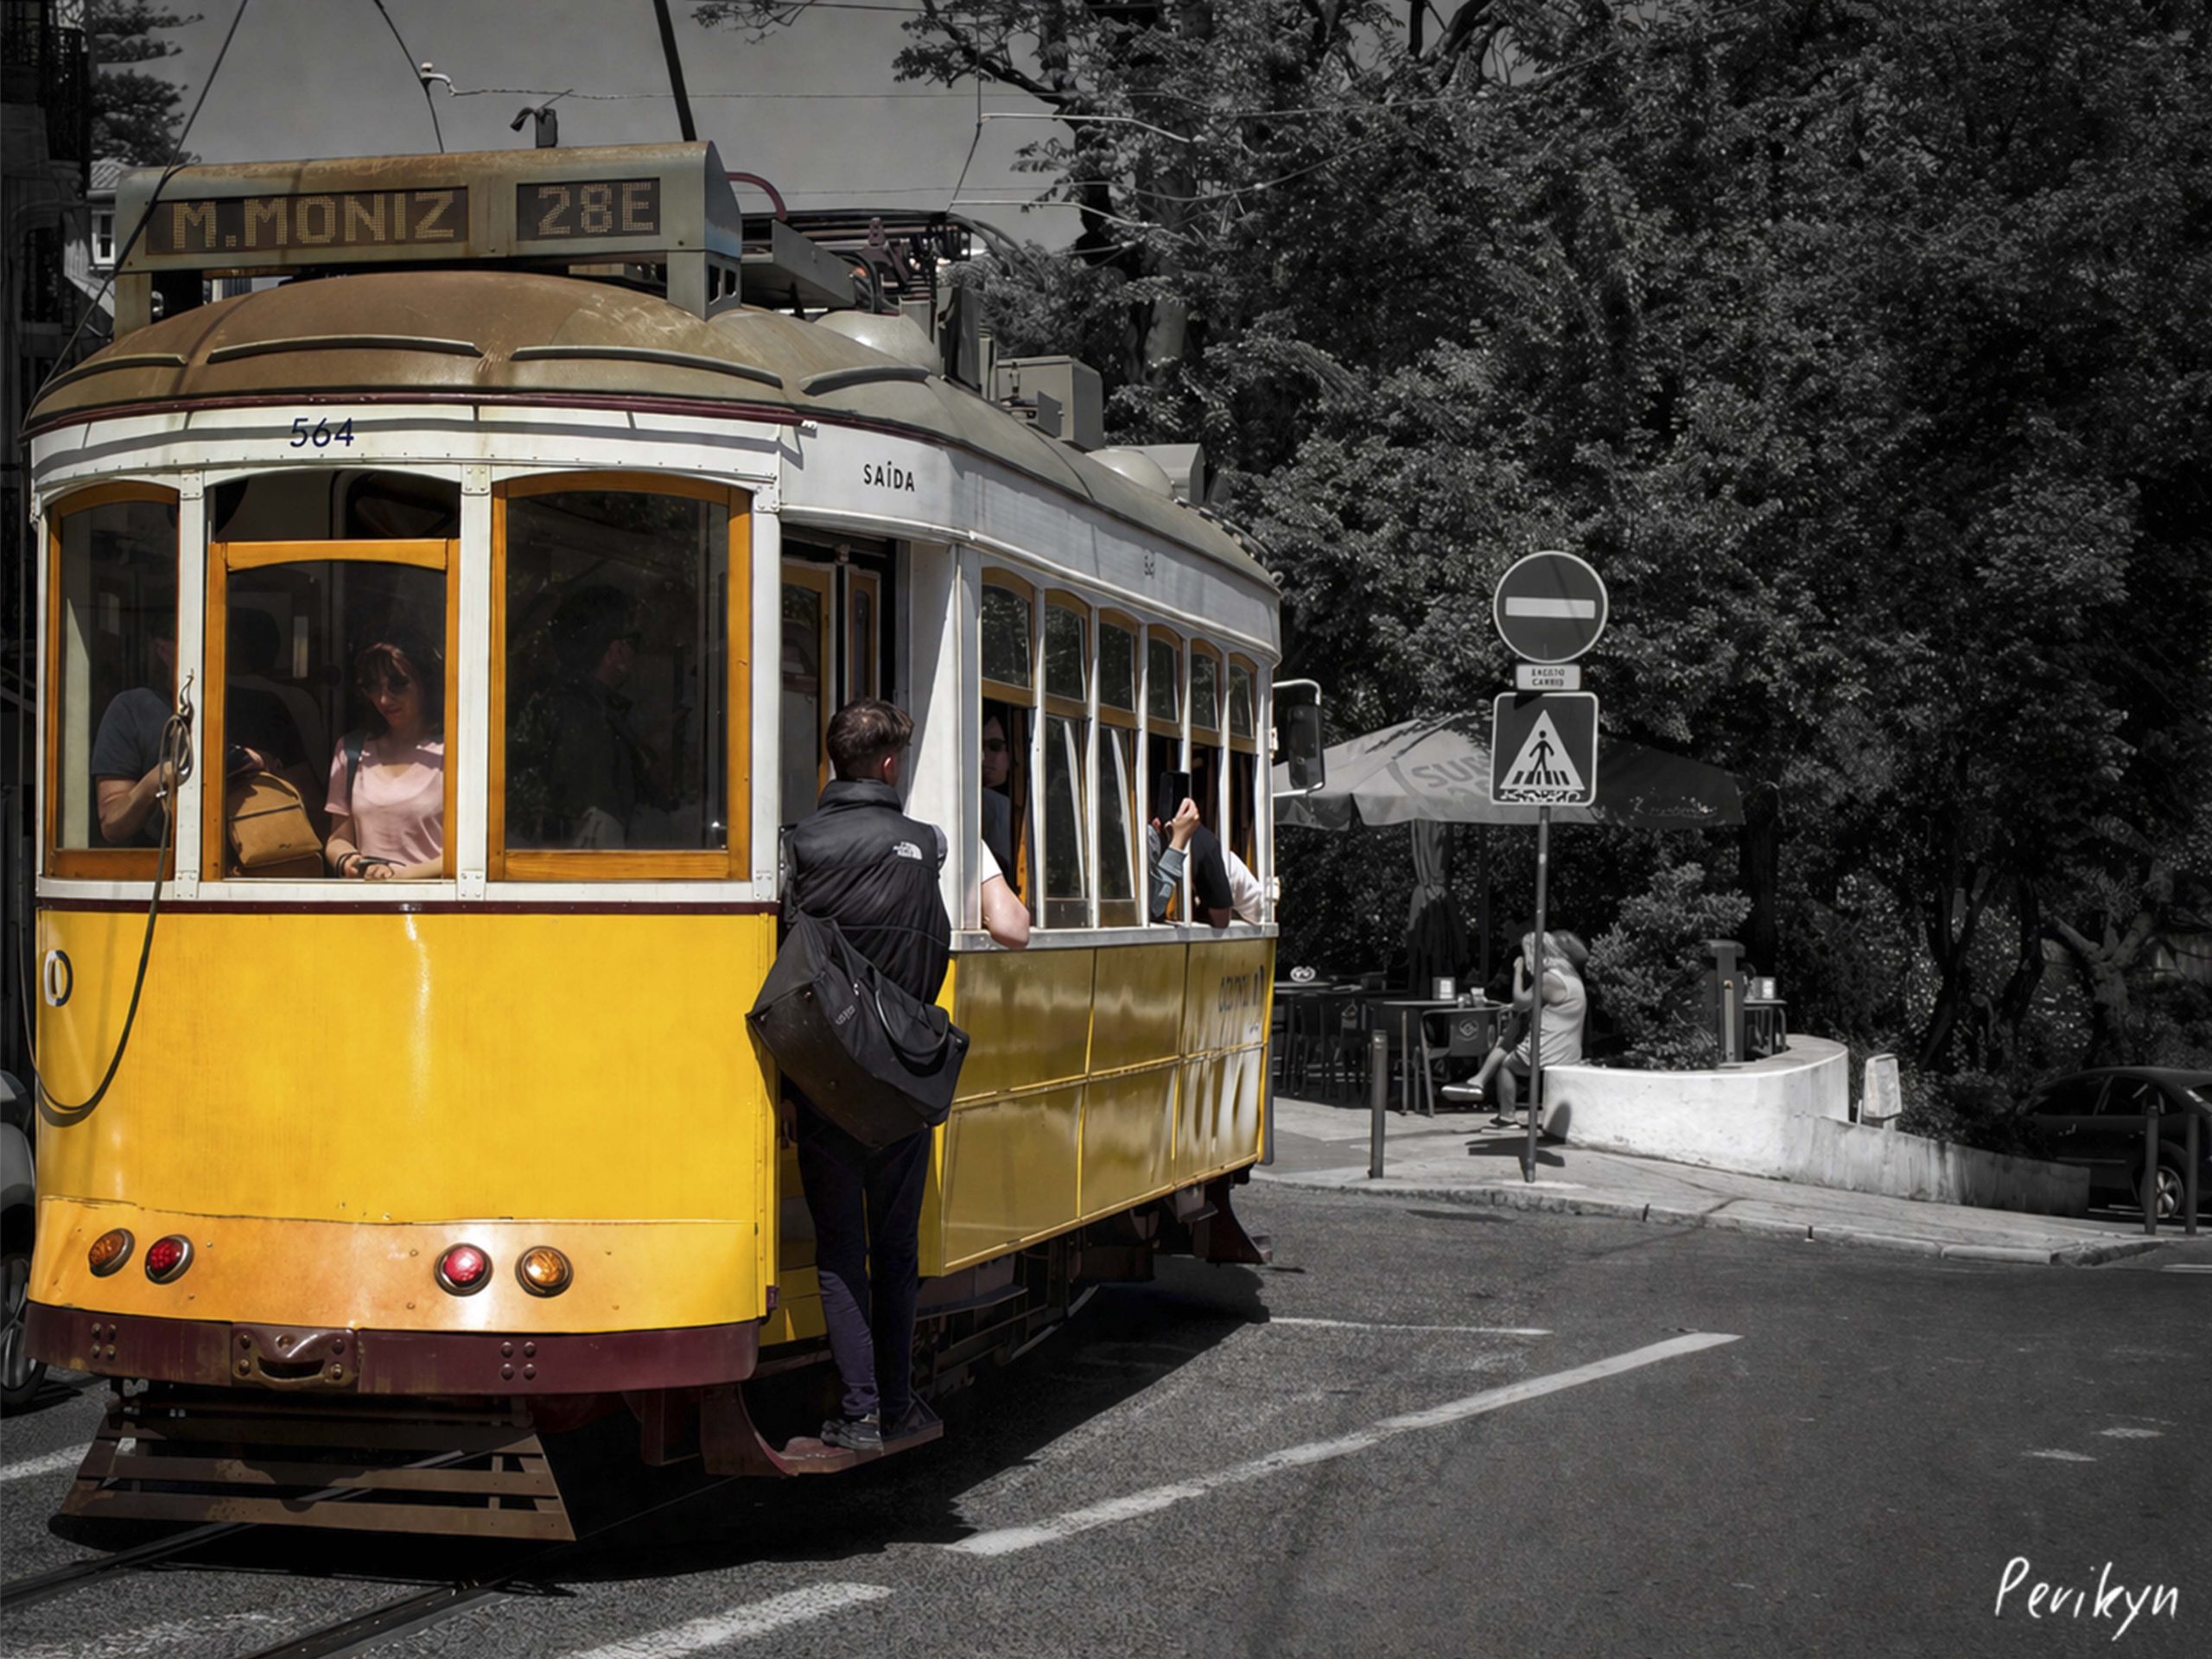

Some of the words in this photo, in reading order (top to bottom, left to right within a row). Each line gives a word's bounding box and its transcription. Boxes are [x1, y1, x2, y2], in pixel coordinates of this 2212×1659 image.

[538, 182, 653, 236] 28E
[290, 417, 354, 448] 564
[863, 461, 915, 493] SAÍDA
